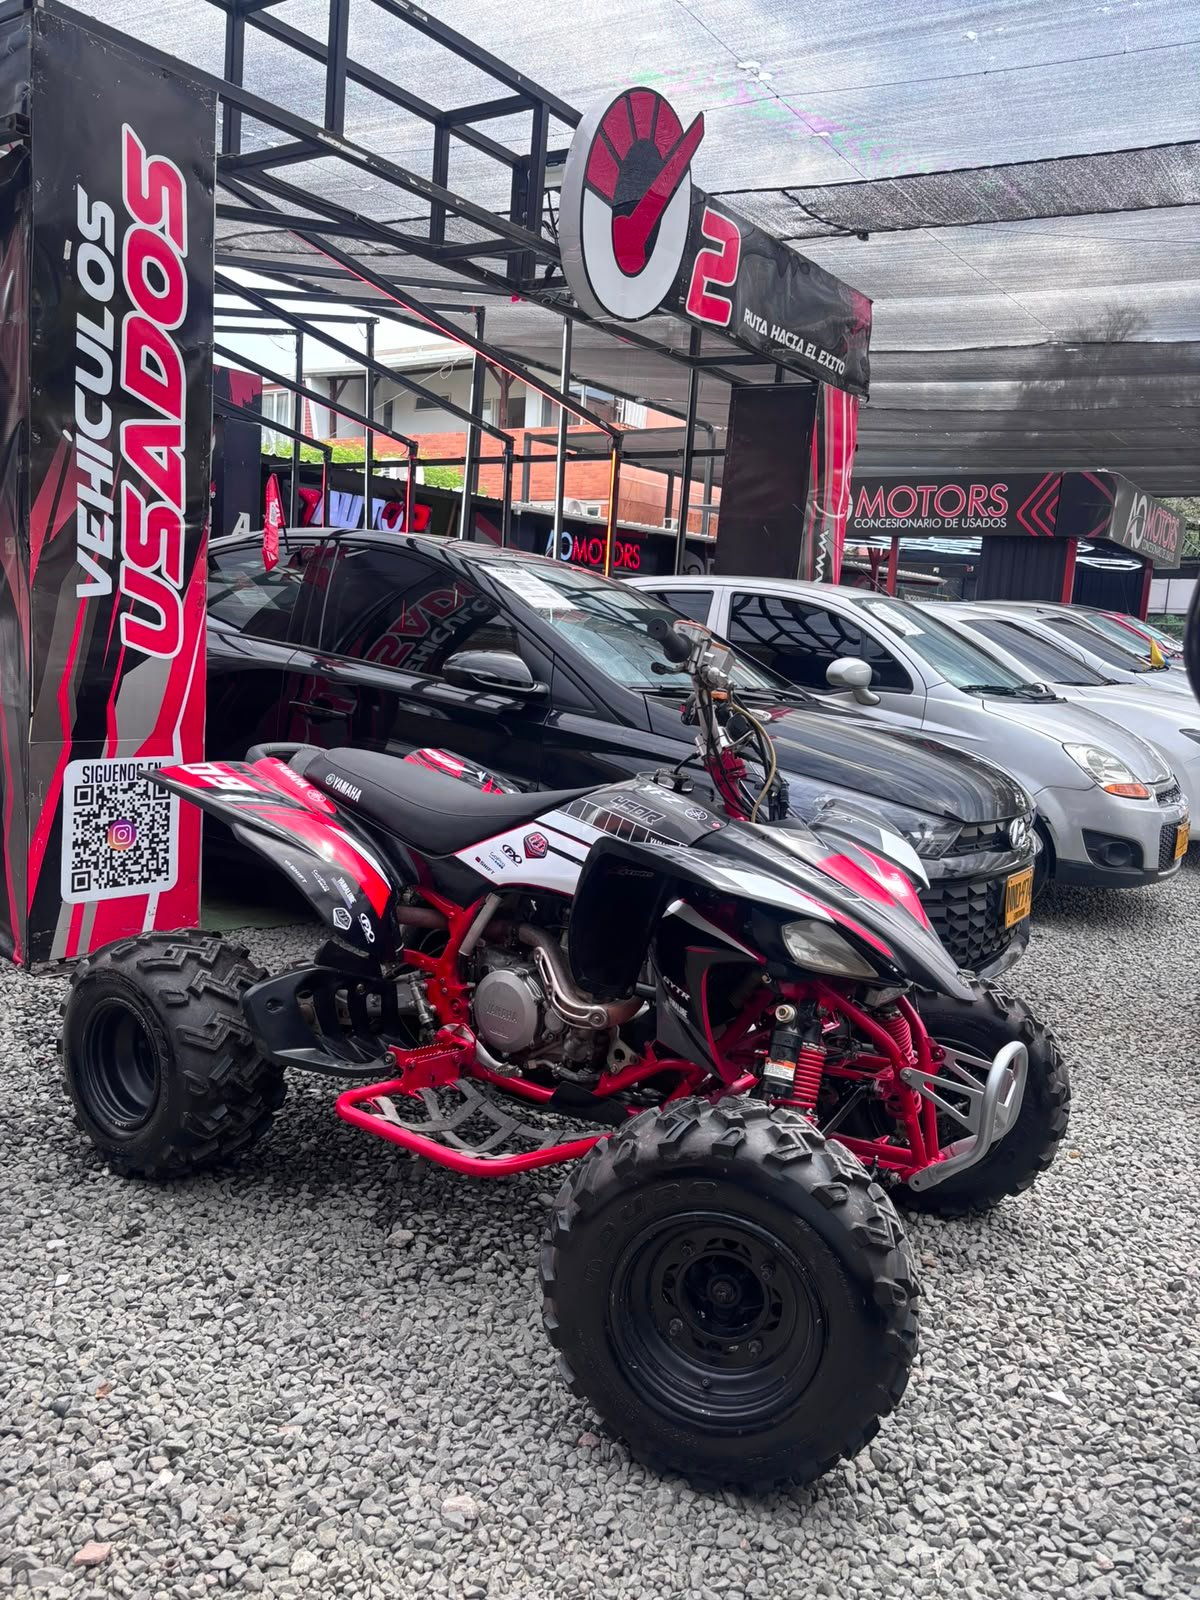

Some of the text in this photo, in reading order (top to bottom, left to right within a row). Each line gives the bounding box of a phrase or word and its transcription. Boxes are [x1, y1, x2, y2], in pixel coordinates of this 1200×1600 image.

[685, 205, 741, 327] 2
[743, 307, 846, 375] RUTA HACIA EL EXITO
[62, 183, 116, 598] VEHÍCULOS
[120, 122, 188, 660] USADOS
[853, 517, 1007, 529] CONCESIONARIO DE USADOS
[854, 483, 1009, 518] MOTORS
[274, 762, 311, 789] YAMAHA
[333, 776, 363, 803] YAMAHA
